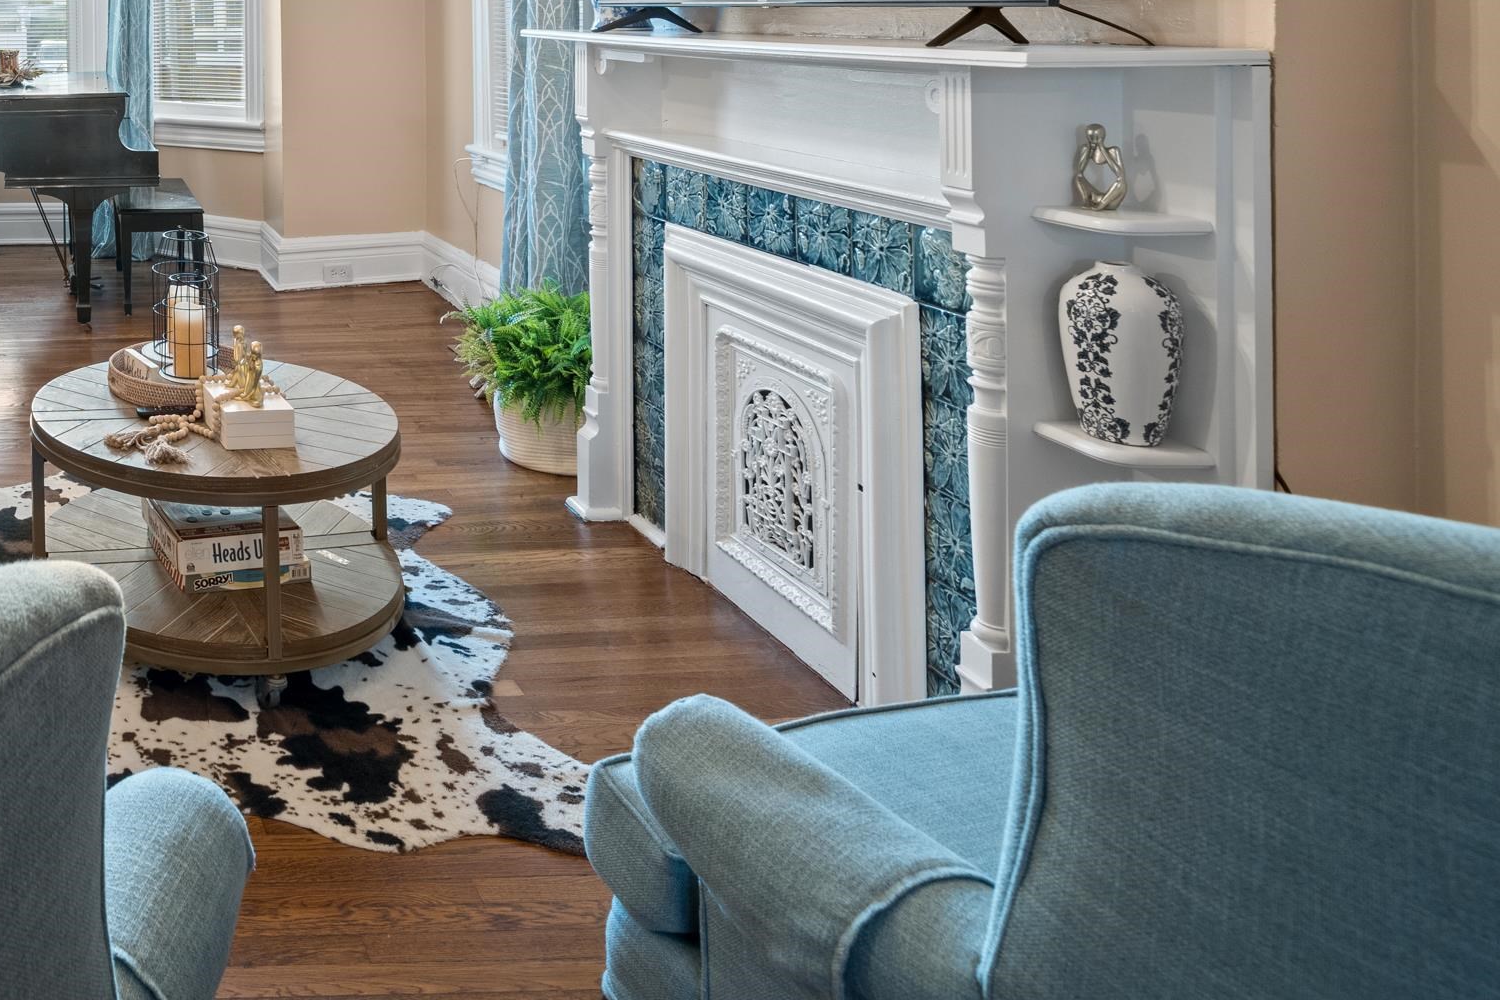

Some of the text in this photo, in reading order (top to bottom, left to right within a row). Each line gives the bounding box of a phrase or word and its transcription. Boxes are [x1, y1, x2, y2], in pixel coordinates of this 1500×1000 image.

[212, 540, 252, 564] Heads
[253, 538, 263, 560] U
[194, 573, 234, 590] SORRY!
